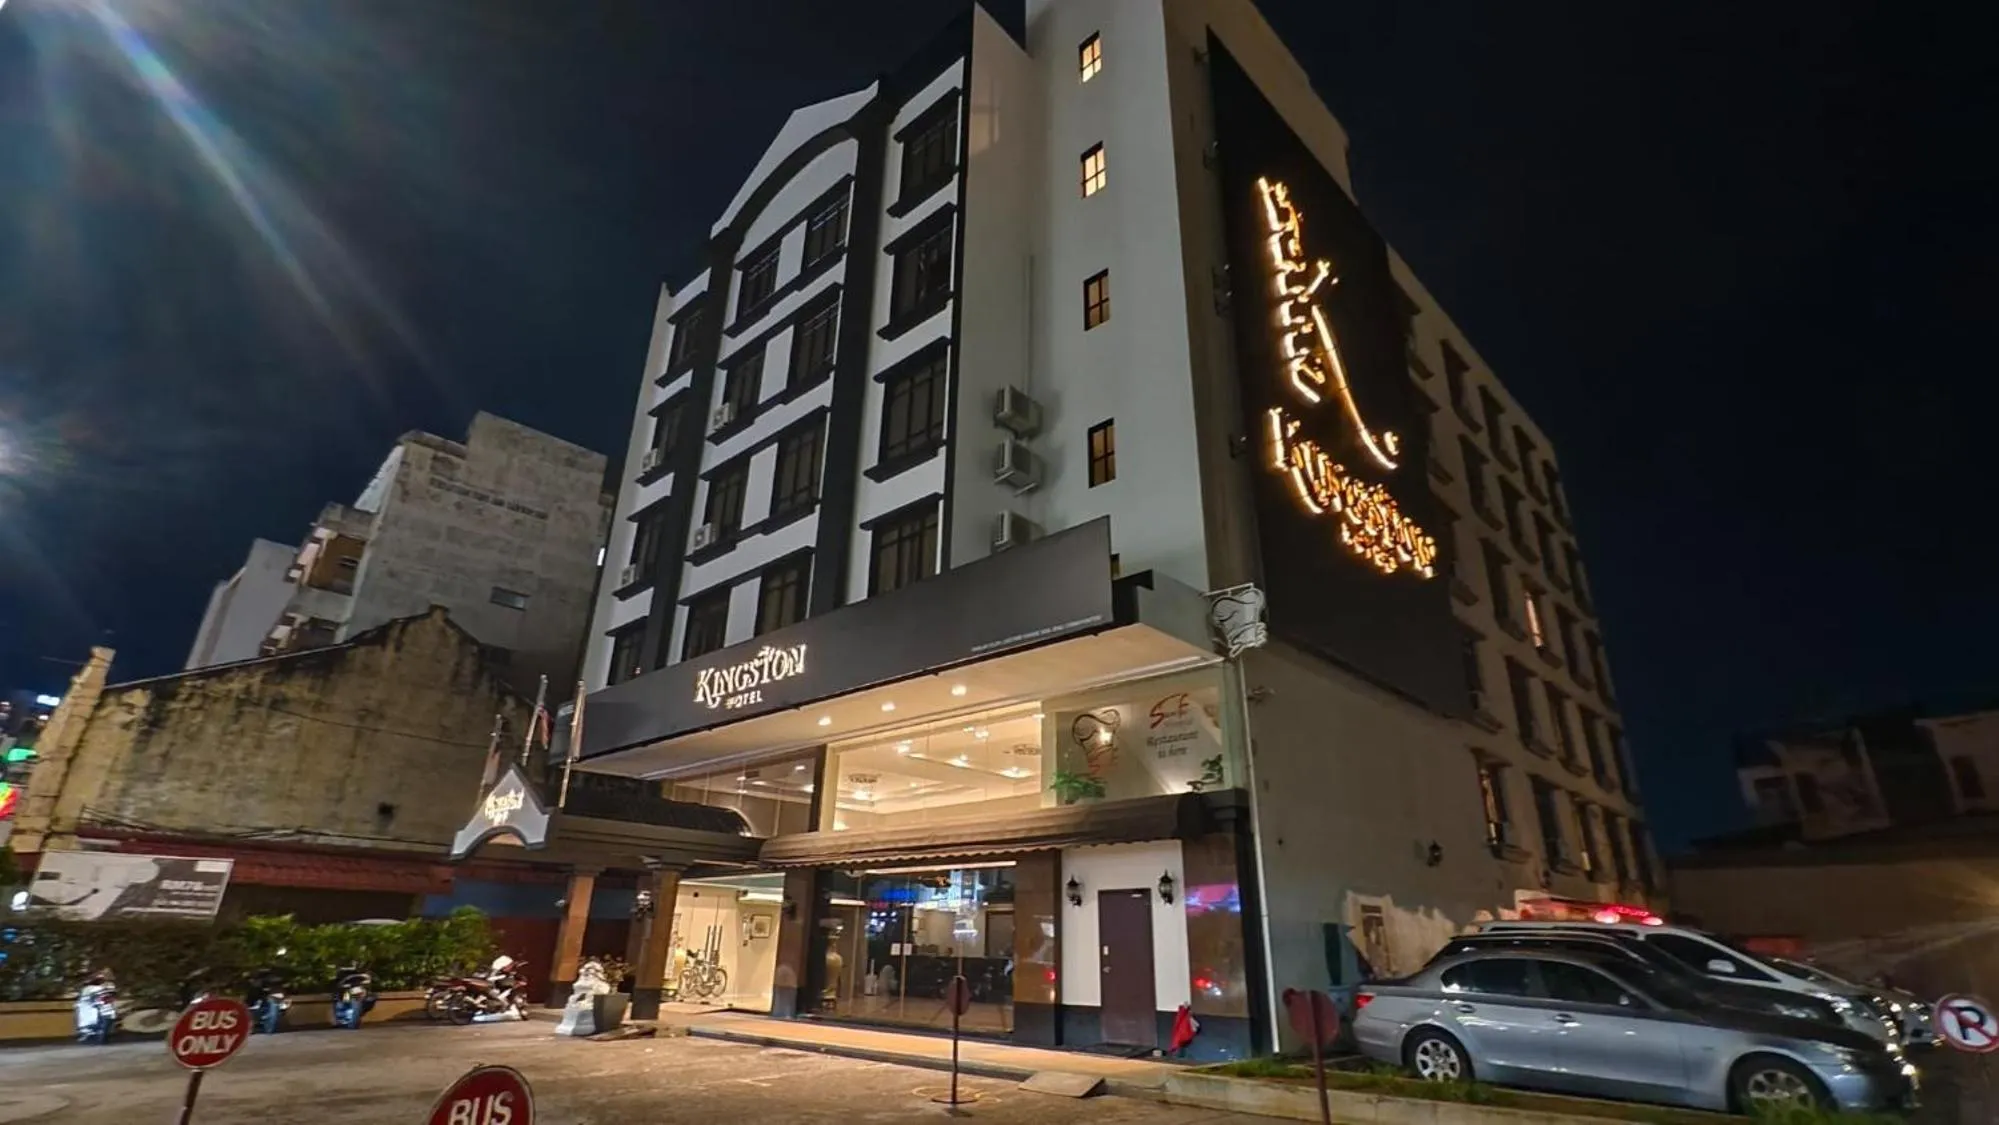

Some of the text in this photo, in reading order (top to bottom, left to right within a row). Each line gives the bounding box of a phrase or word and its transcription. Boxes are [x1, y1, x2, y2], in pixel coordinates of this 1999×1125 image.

[693, 643, 807, 709] KINGSTON
[190, 1009, 239, 1030] BUS
[178, 1034, 240, 1056] ONLY
[447, 1091, 514, 1125] BUS
